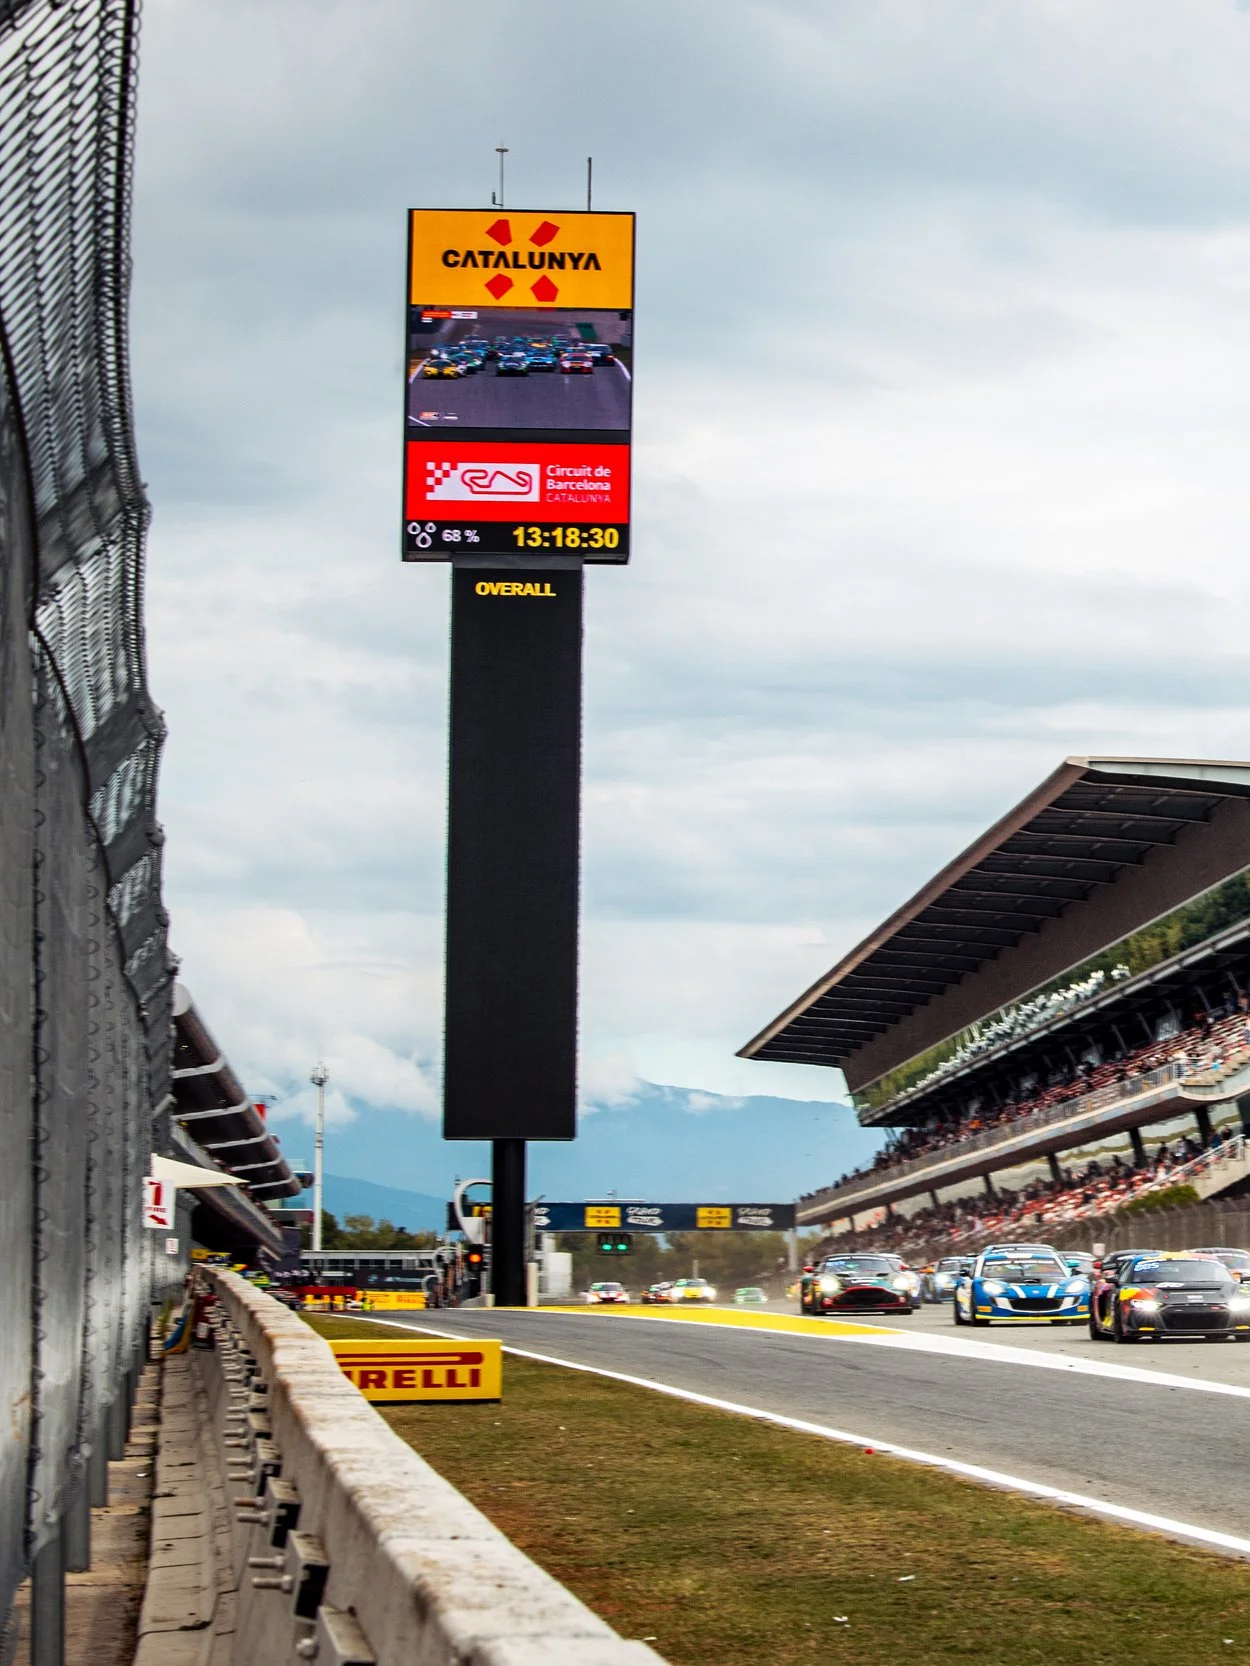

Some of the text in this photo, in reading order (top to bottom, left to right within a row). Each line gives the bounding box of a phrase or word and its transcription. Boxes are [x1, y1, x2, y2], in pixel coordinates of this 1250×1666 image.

[441, 249, 602, 271] CATALUNYA
[546, 464, 611, 477] Circuit de
[546, 478, 611, 491] Barcelona
[546, 493, 611, 503] CATALUNYA
[441, 529, 480, 543] 68 %
[513, 526, 620, 548] 13:18:30
[475, 581, 557, 597] OVERALL
[343, 1368, 481, 1390] RELLI
